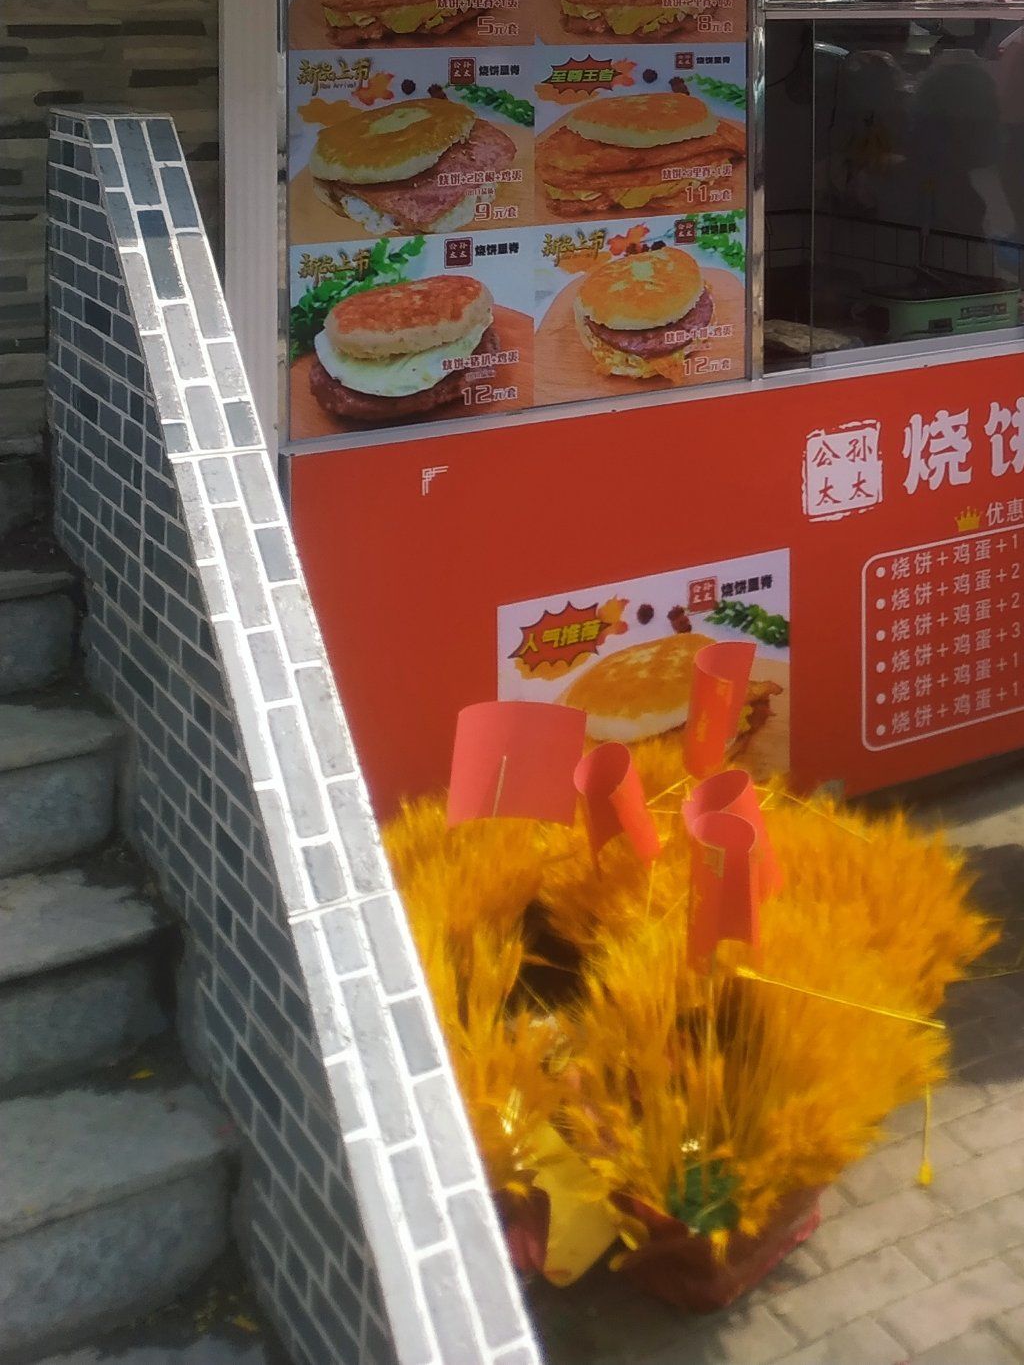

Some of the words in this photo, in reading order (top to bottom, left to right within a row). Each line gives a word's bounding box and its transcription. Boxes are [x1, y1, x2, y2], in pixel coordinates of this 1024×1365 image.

[550, 68, 617, 83] 至尊王者
[812, 435, 873, 468] 公孙
[816, 472, 873, 506] 太太
[519, 618, 602, 655] 人气推荐
